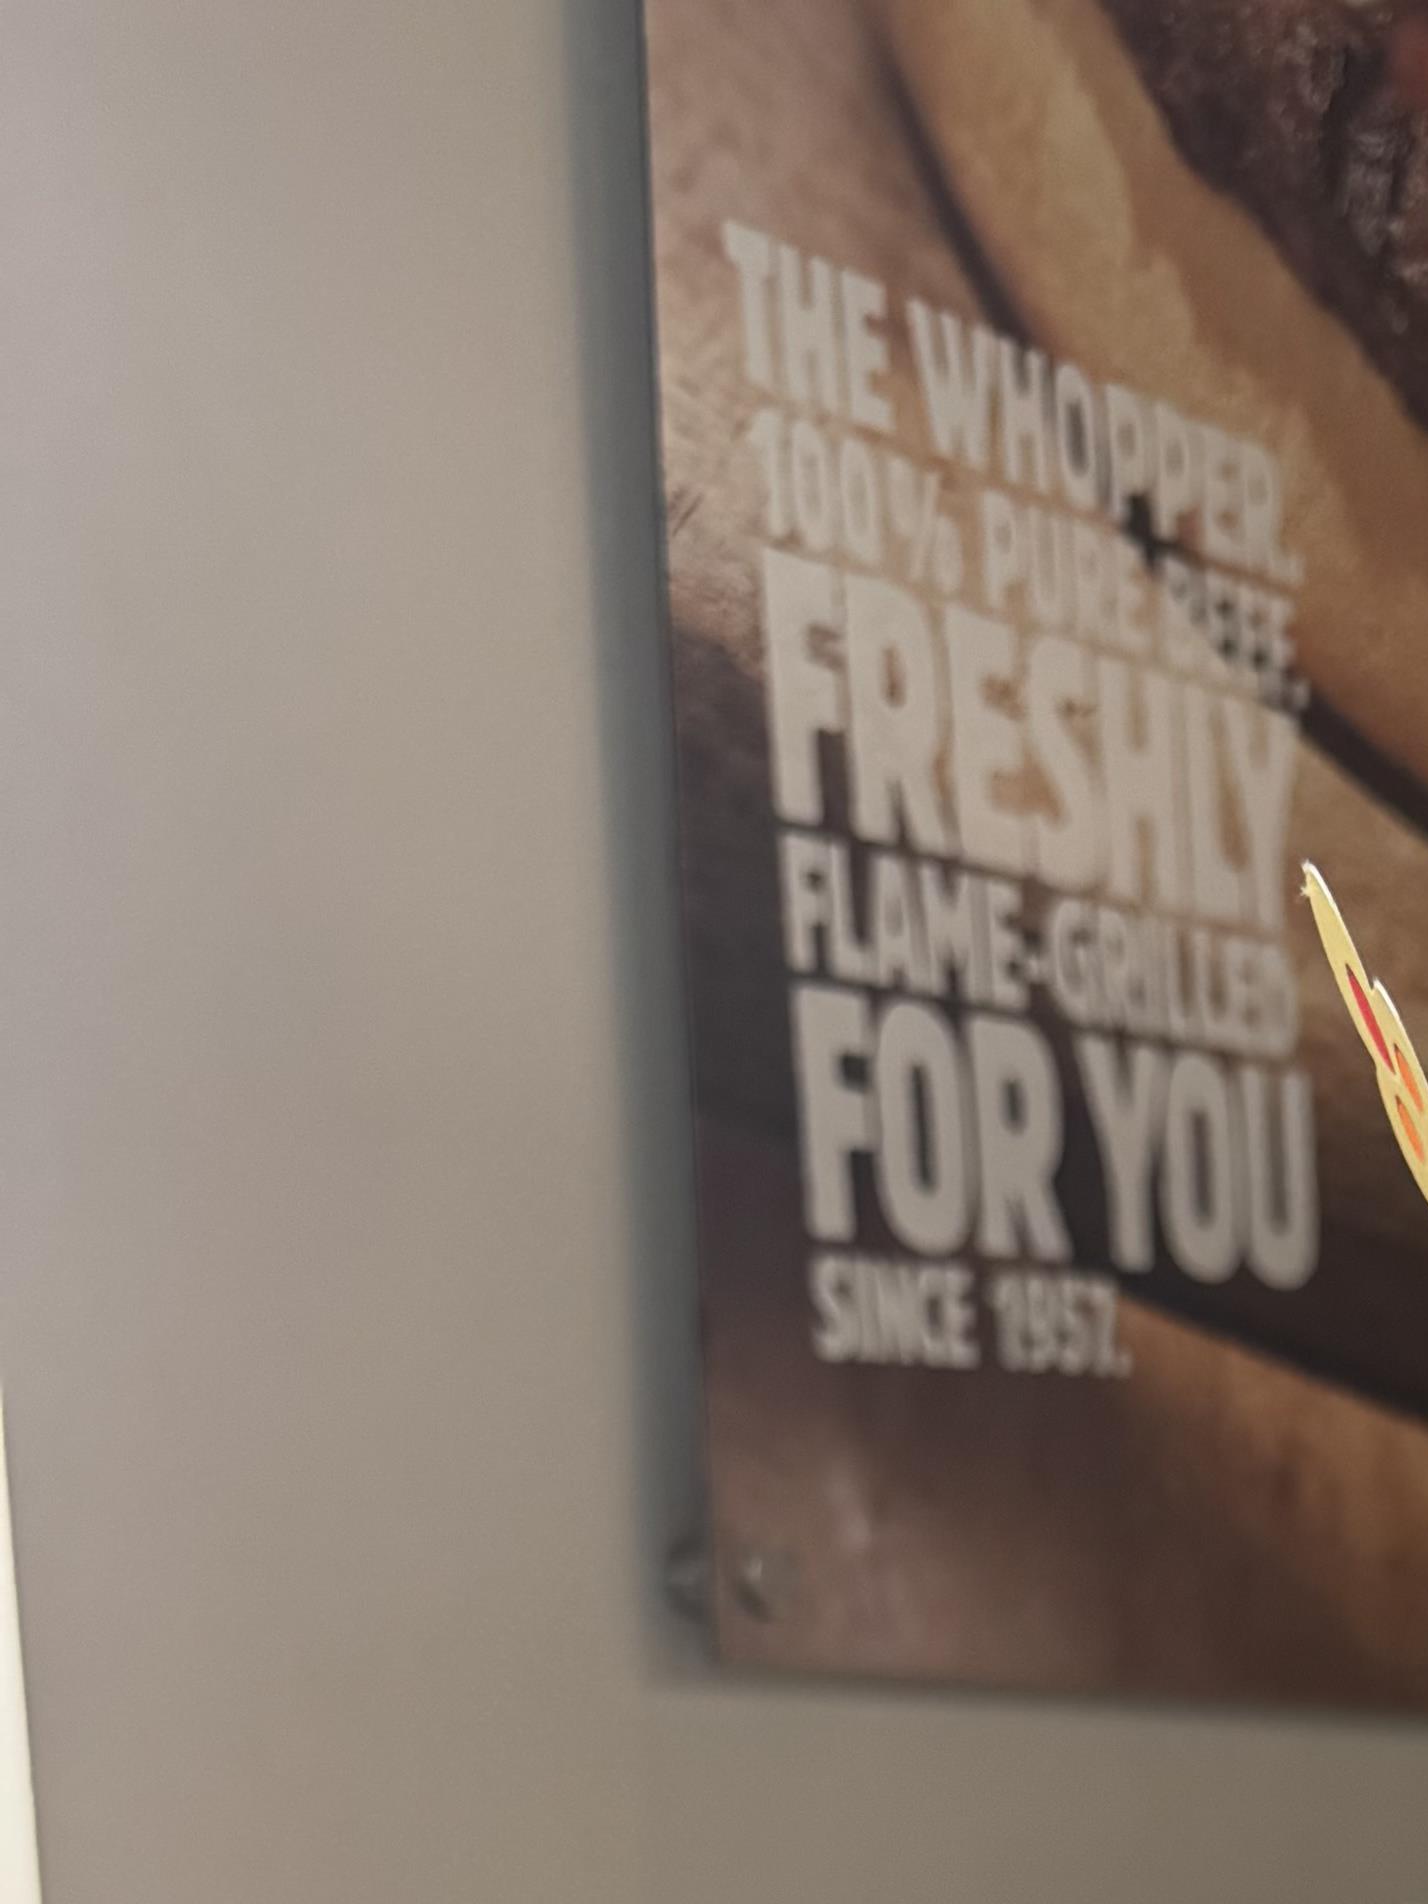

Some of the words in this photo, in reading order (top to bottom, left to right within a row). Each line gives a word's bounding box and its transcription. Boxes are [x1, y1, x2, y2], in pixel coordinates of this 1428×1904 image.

[722, 218, 897, 430] THE
[745, 406, 962, 593] 100%
[984, 488, 1155, 652] PURE
[764, 548, 1302, 928] FRESHLY
[782, 832, 1298, 1063] FLAME-GRILLED
[793, 983, 1074, 1258] FOR
[1073, 1032, 1321, 1289] YOU
[810, 1254, 981, 1370] SINCE
